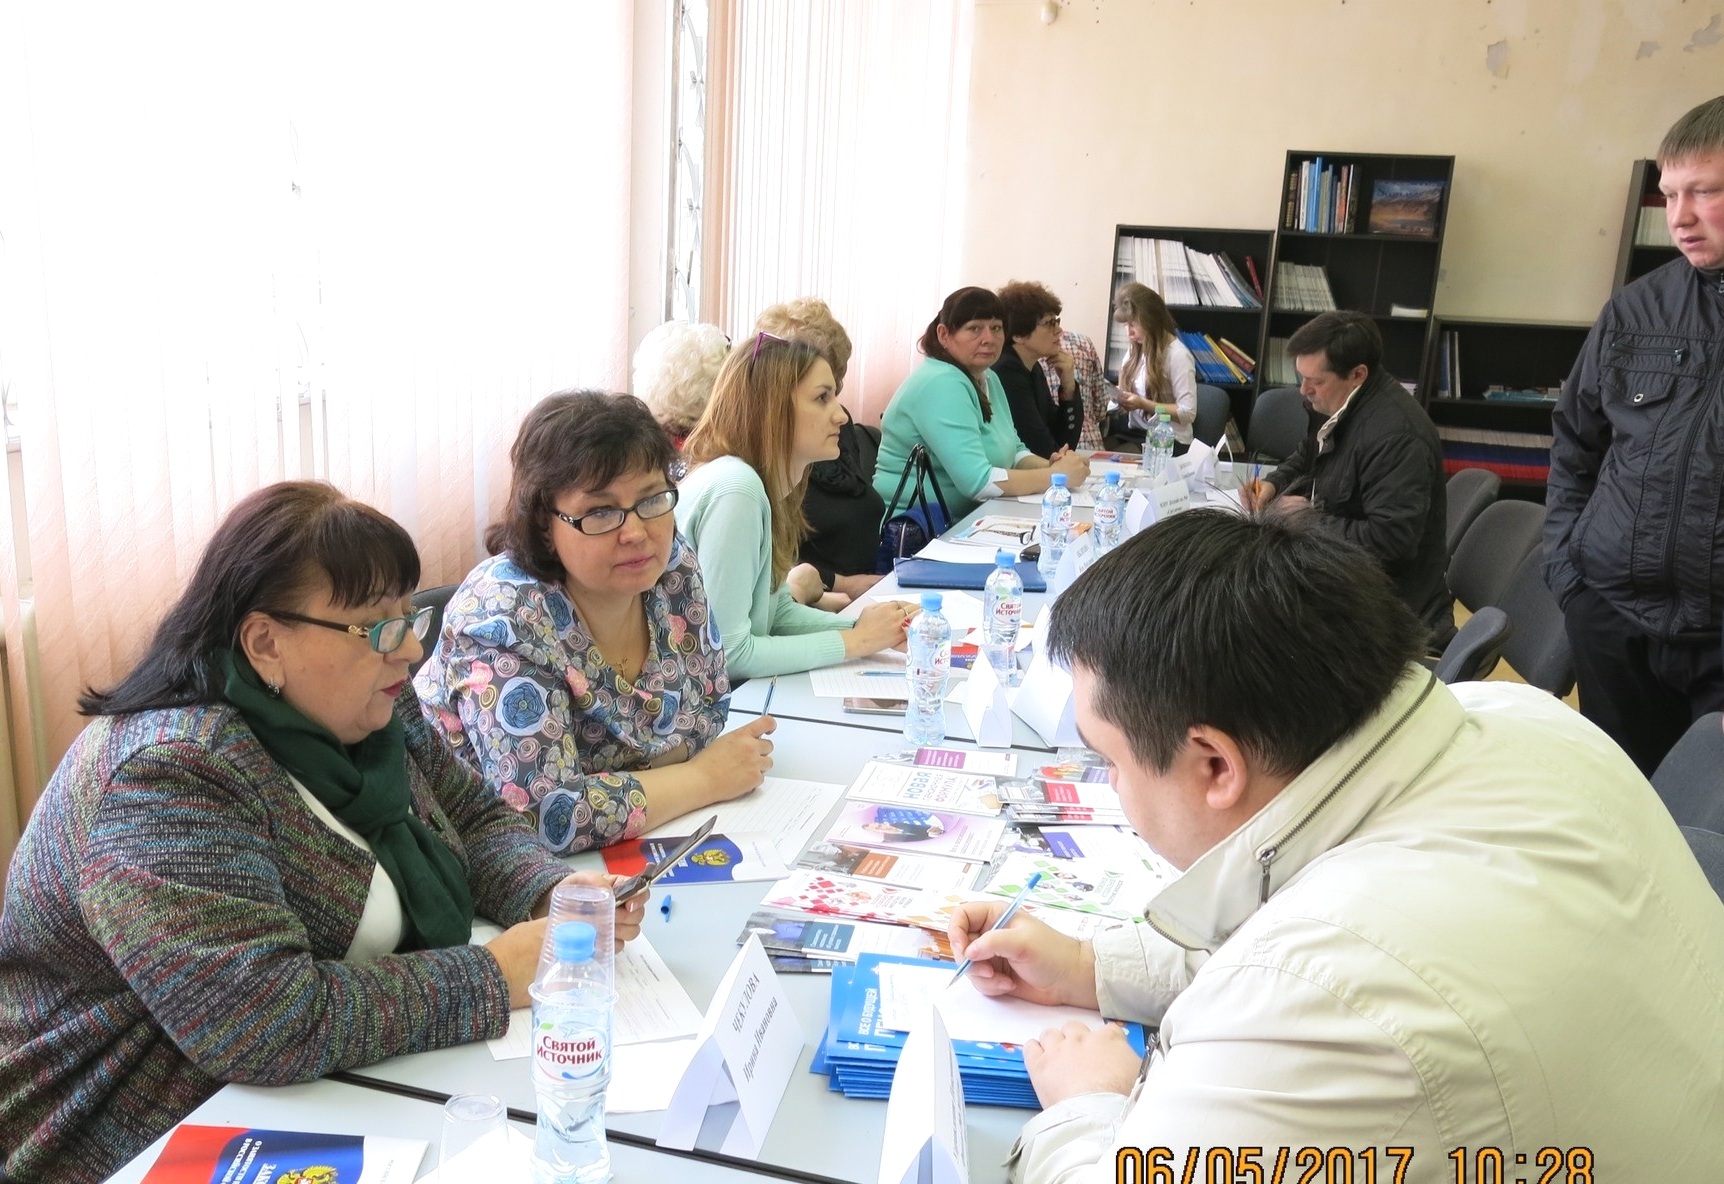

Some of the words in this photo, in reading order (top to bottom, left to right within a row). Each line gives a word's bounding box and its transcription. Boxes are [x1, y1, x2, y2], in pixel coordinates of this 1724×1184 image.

[543, 1035, 596, 1053] Святой
[743, 1044, 759, 1083] Ирина
[754, 996, 778, 1048] Ивановна
[537, 1043, 605, 1065] Источник
